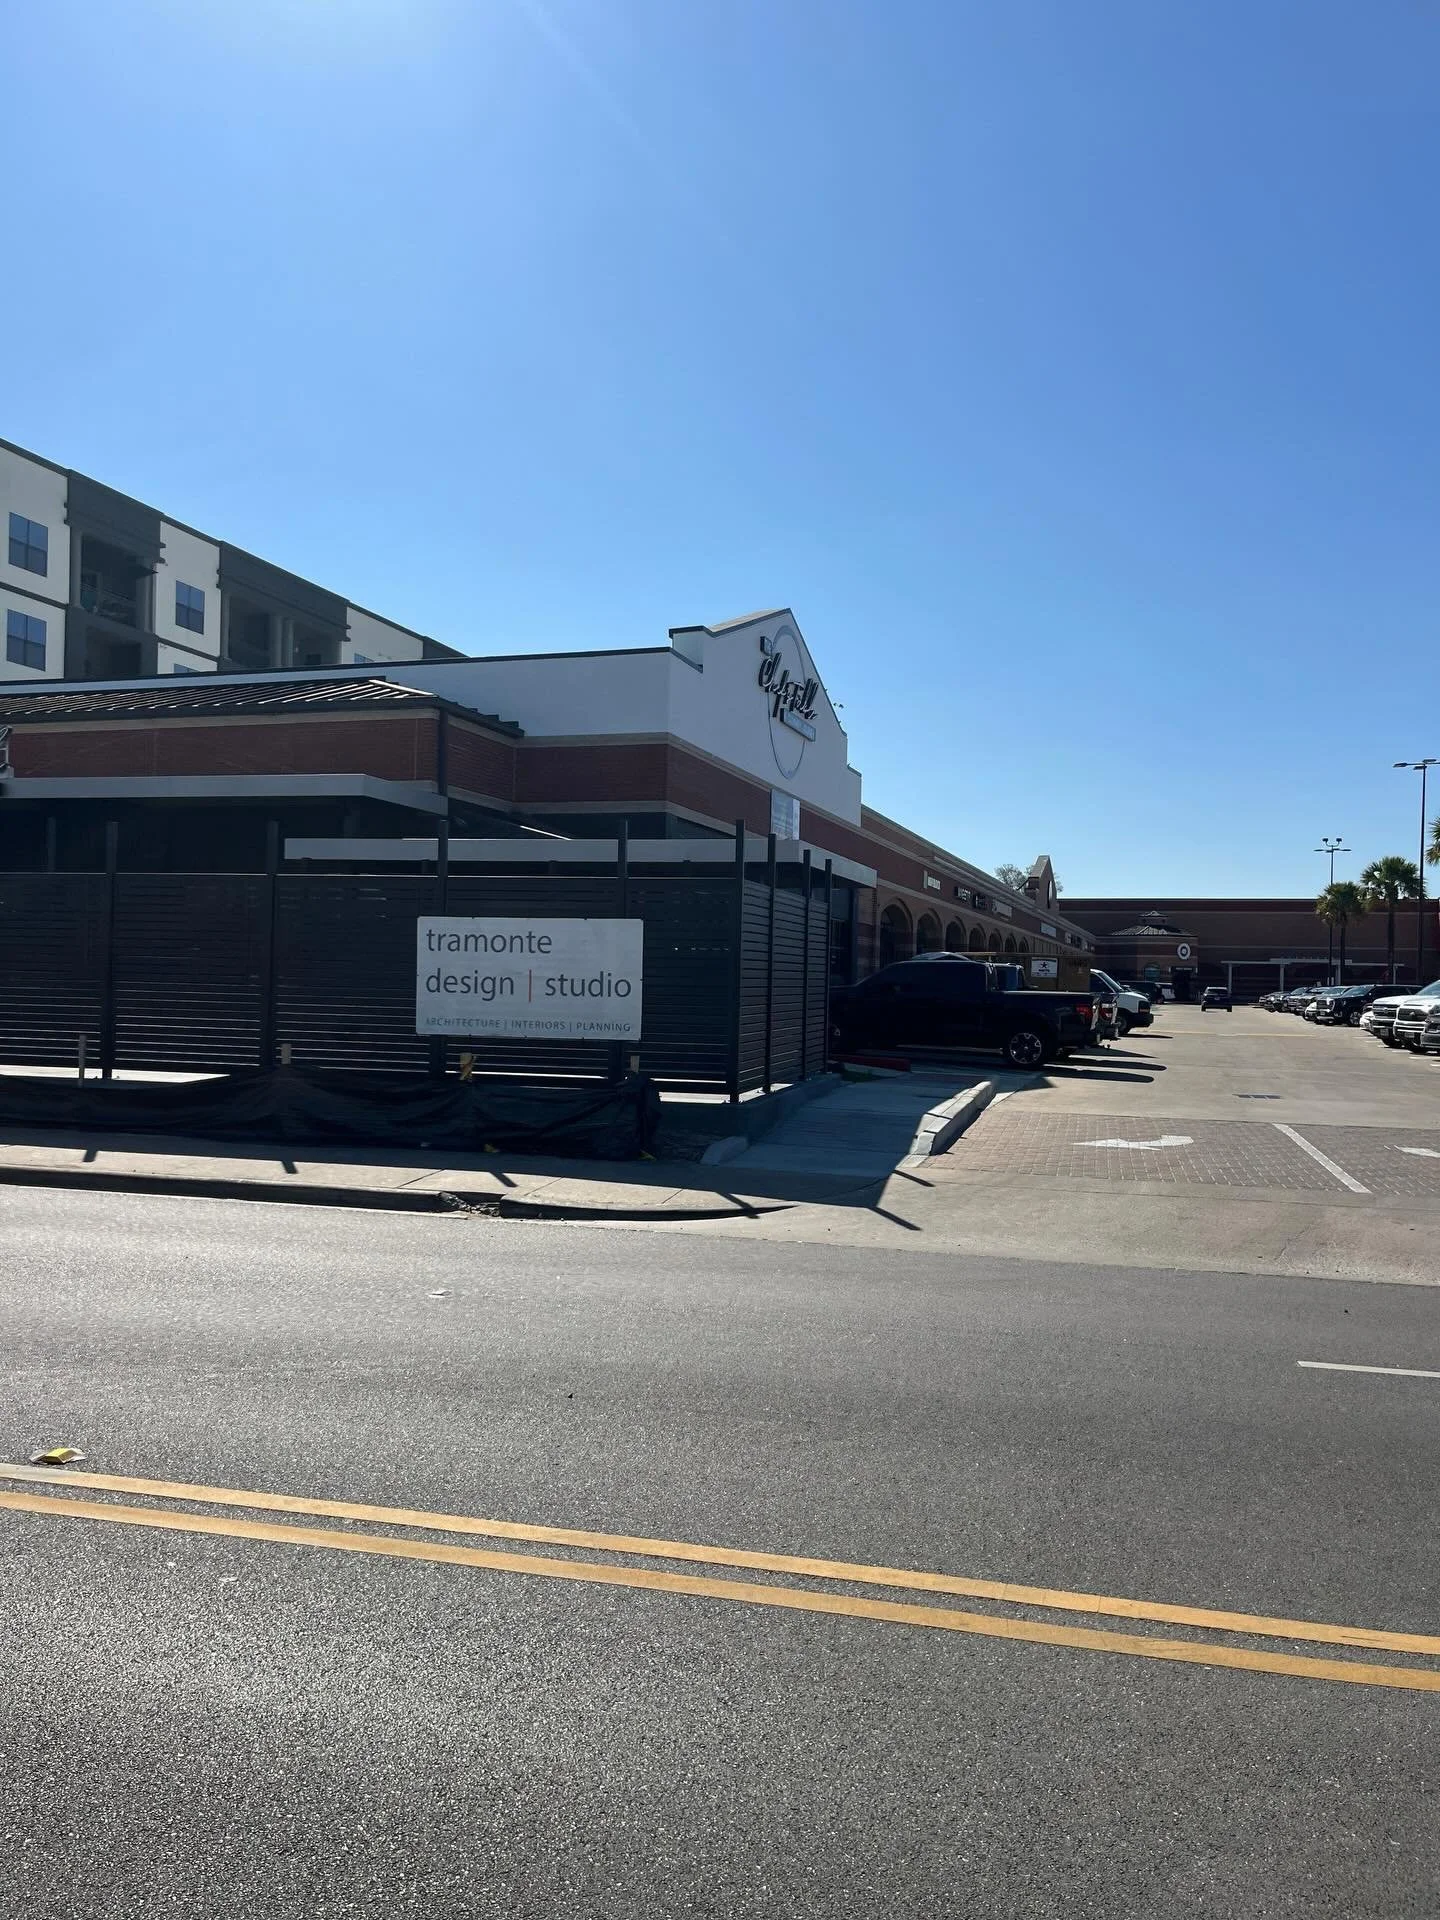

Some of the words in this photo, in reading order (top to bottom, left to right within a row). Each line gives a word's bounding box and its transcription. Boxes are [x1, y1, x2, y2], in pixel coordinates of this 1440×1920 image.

[426, 929, 553, 954] tramonte
[426, 967, 515, 1001] design
[544, 971, 632, 998] studio
[425, 1017, 500, 1029] ARCHITECTURE
[511, 1019, 566, 1031] INTERIORS
[576, 1022, 631, 1032] PLANNING
